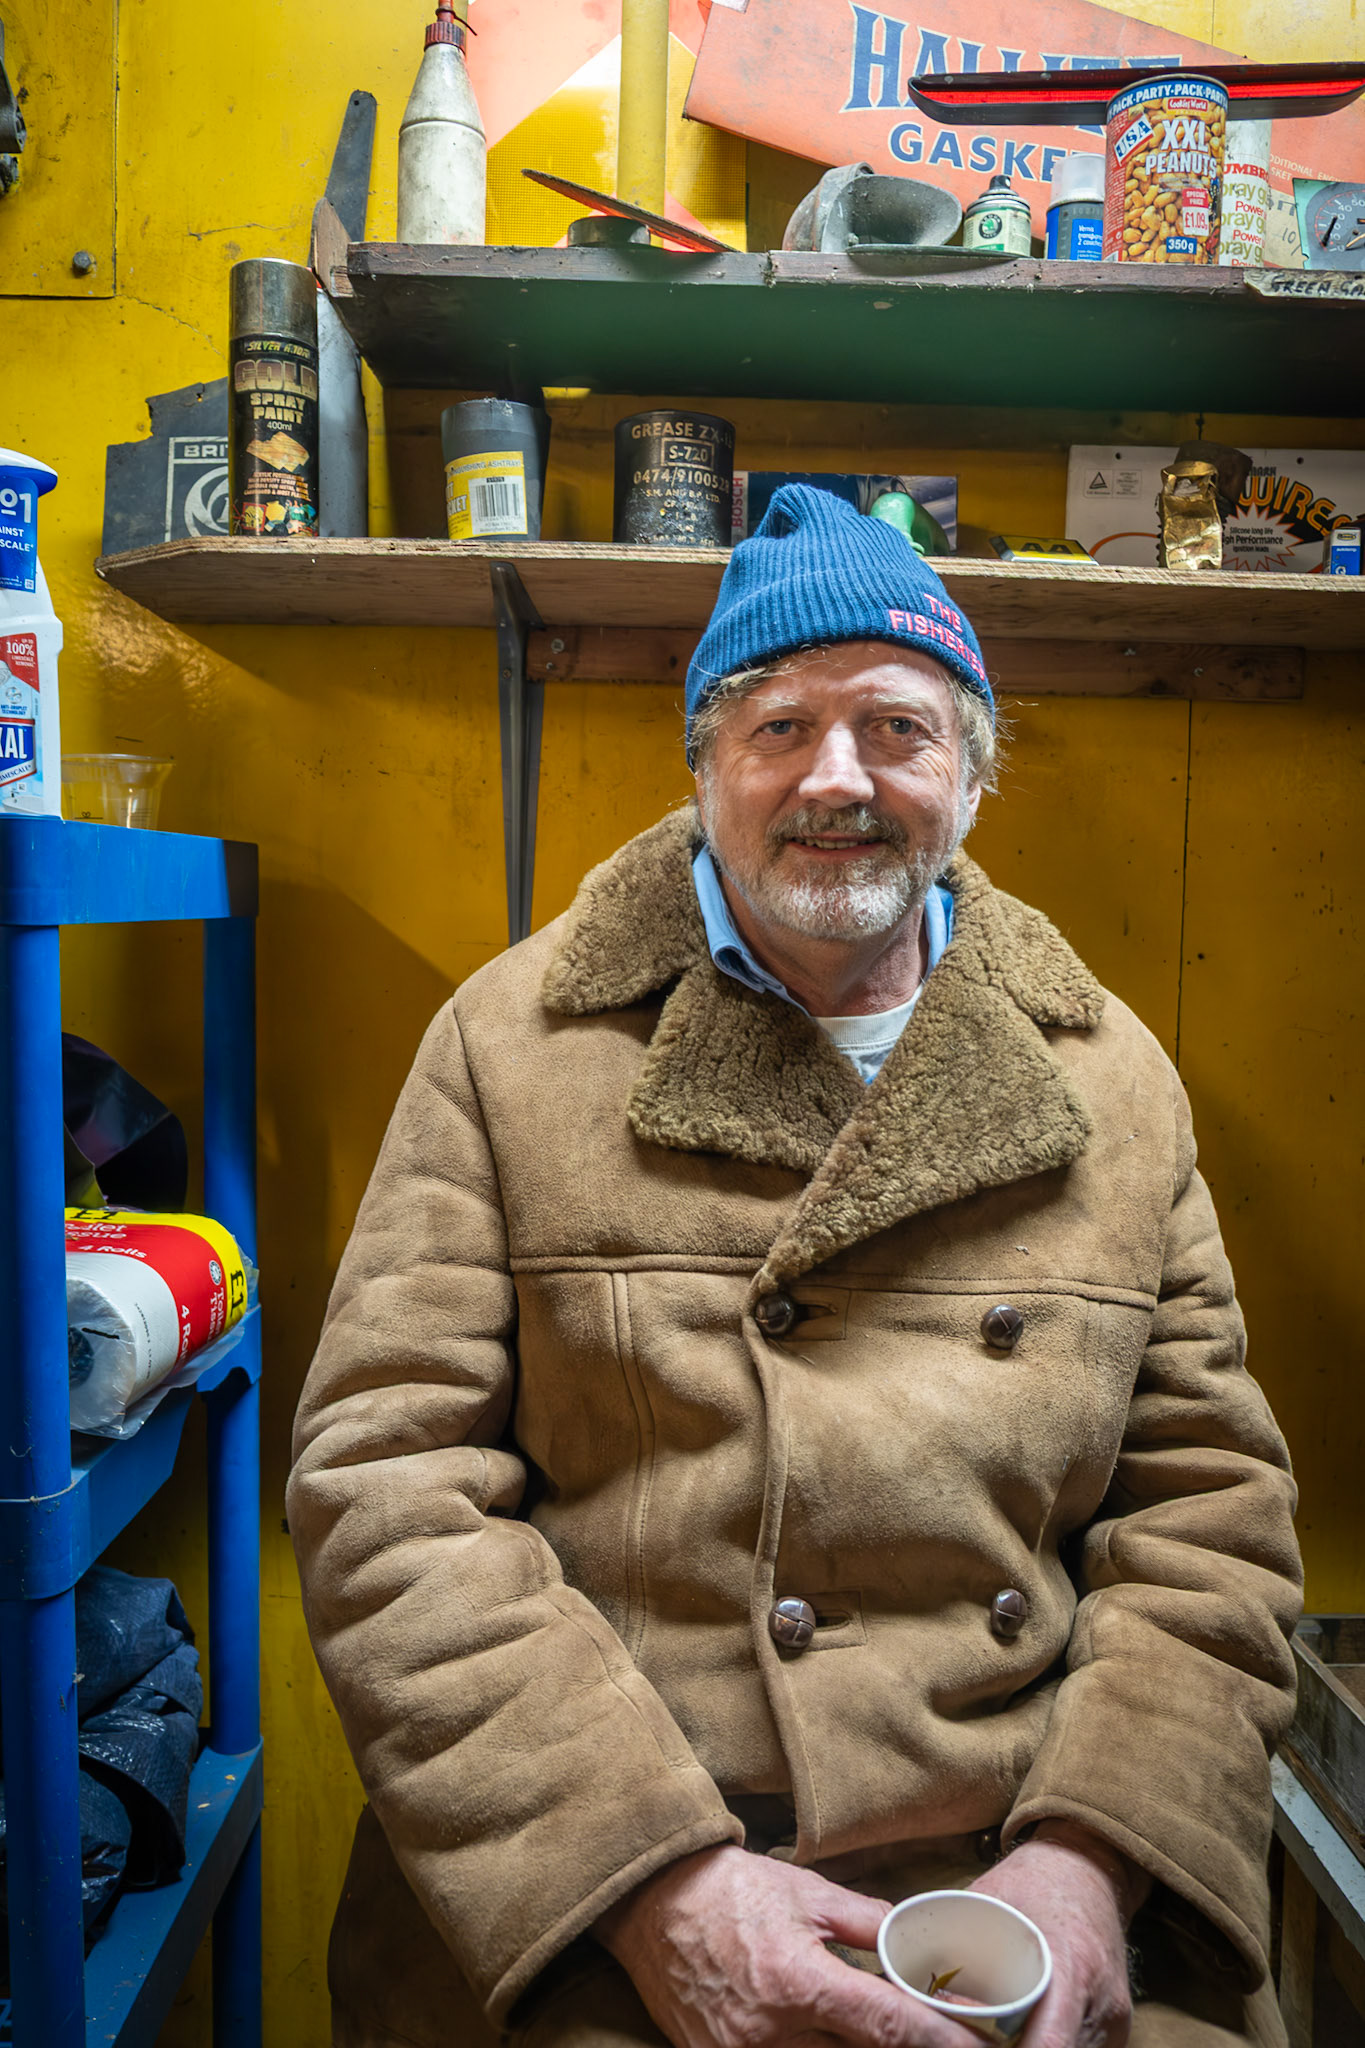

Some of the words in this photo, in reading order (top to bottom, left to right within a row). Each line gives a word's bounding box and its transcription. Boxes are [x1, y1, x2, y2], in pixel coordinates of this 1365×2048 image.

[1115, 120, 1153, 158] USA
[1160, 119, 1209, 153] XXL
[888, 123, 1086, 182] GASKE
[1144, 151, 1217, 179] PEANUTS
[1186, 190, 1206, 199] SPECIAL
[1235, 201, 1264, 217] Power
[1233, 230, 1261, 246] Power
[1271, 273, 1332, 295] GREEN
[1340, 279, 1365, 296] GA
[247, 341, 281, 352] SILVER
[235, 359, 317, 400] GOLD
[250, 393, 305, 411] SPRAY
[253, 407, 303, 424] PAINT
[267, 420, 292, 431] 400ml
[632, 421, 694, 439] GREASE
[184, 444, 229, 457] BRI
[669, 445, 708, 461] S-720
[731, 477, 744, 527] BOSCH
[1251, 527, 1264, 536] long
[1264, 527, 1274, 535] life
[1235, 535, 1283, 545] Performance
[1021, 543, 1073, 555] AA
[924, 593, 963, 633] THE
[6, 642, 35, 657] 100%
[888, 609, 985, 681] FISHERIES
[97, 1245, 147, 1258] Rolls
[230, 1269, 245, 1317] £1
[181, 1304, 190, 1319] 4
